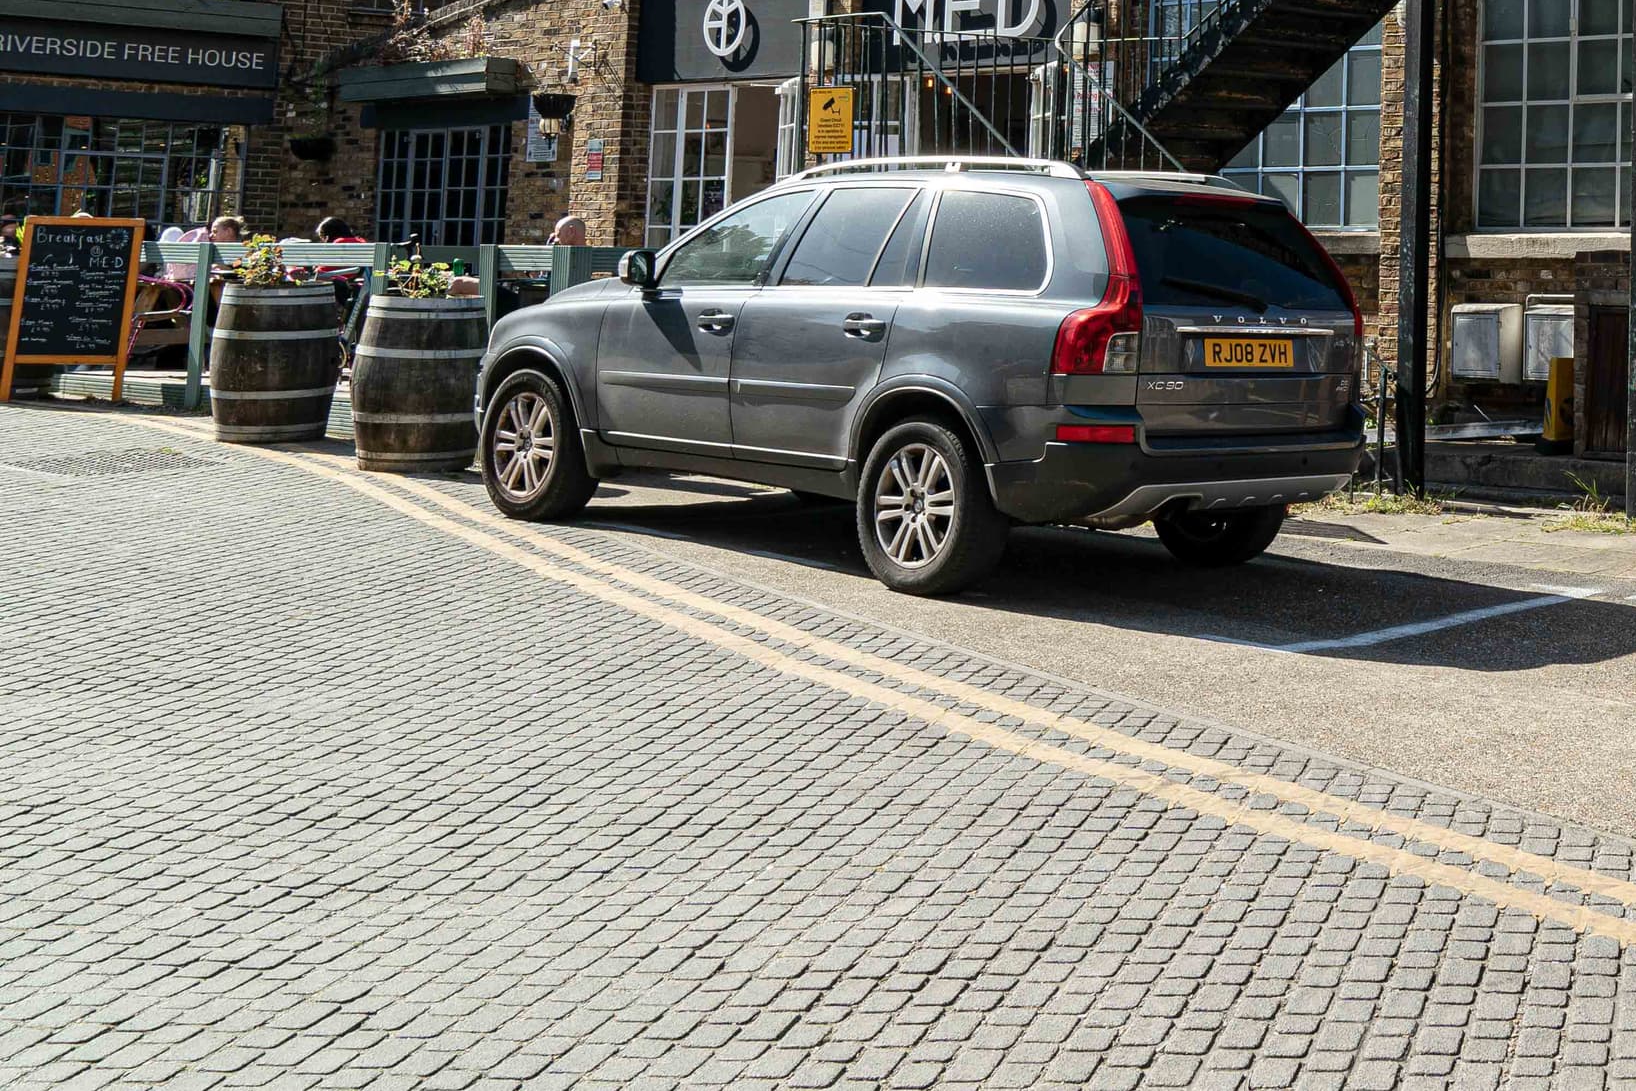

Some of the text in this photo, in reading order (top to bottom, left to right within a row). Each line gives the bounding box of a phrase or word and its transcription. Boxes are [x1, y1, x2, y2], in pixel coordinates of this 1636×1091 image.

[124, 43, 181, 65] FREE
[187, 48, 265, 70] HOUSE
[36, 226, 106, 251] Breakfast
[1212, 314, 1308, 326] VOLVO
[1212, 342, 1288, 365] RJ08 ZVH
[1146, 381, 1185, 391] XC90
